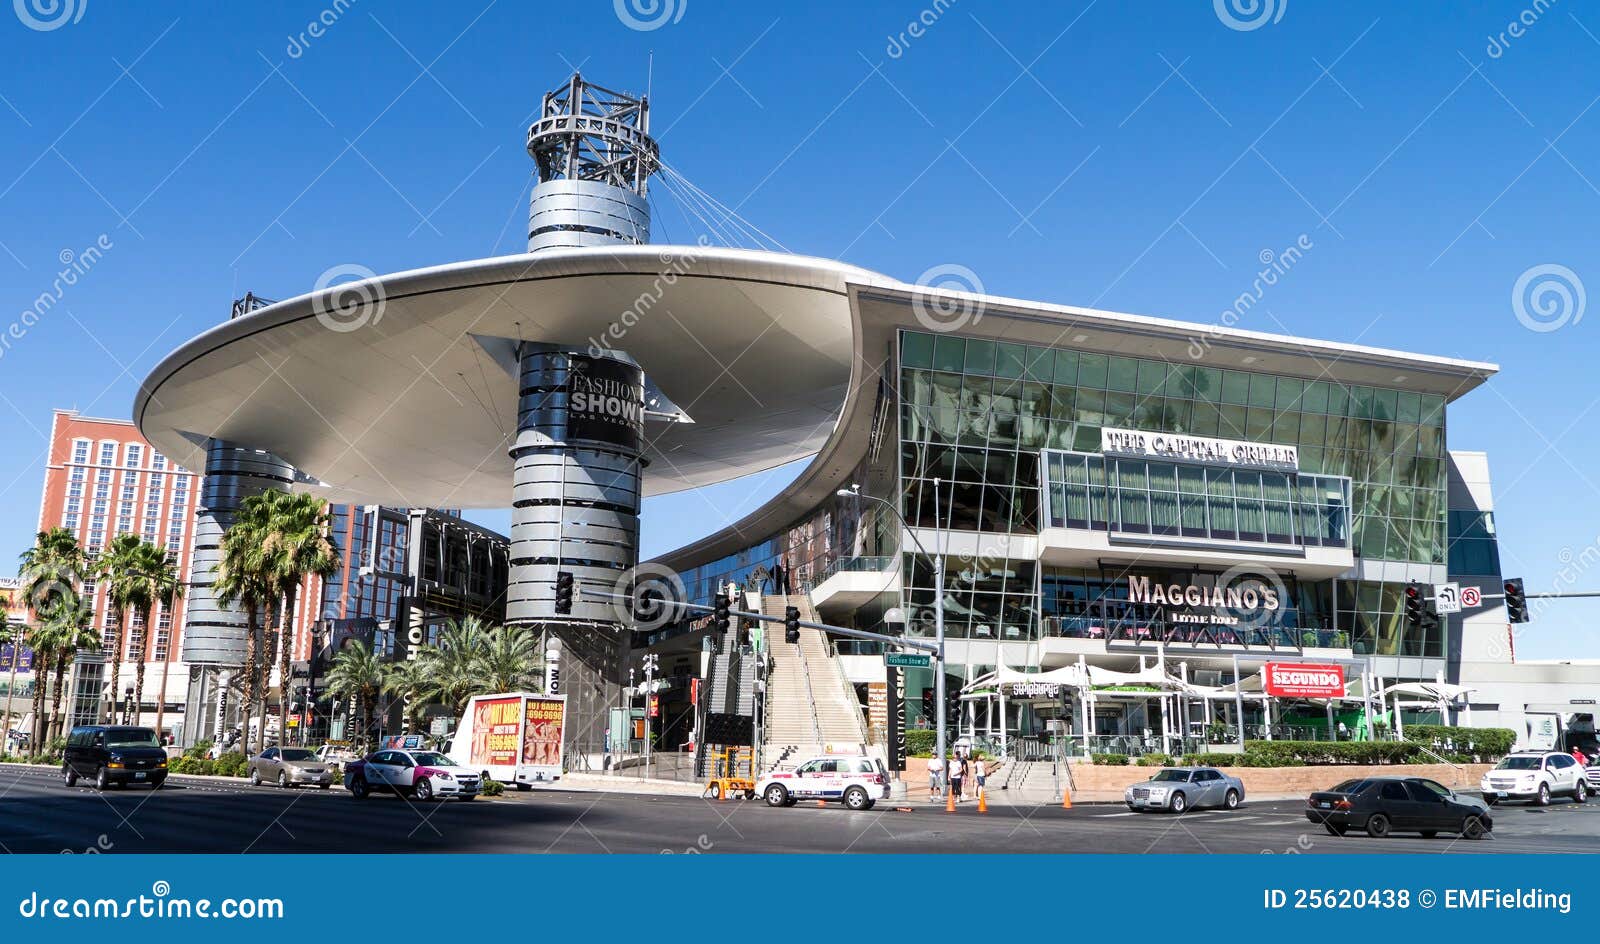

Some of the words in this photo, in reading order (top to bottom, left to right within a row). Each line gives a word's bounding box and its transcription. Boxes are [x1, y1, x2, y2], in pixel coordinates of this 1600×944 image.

[573, 376, 638, 401] FASHION
[571, 392, 639, 421] SHOW
[604, 416, 637, 429] VEGAS
[1107, 431, 1146, 448] THE
[1152, 436, 1226, 458] CAPITAL
[1231, 444, 1297, 464] GRILLE
[1128, 575, 1279, 610] MAGGIANO'S
[407, 605, 424, 660] HOW
[1272, 672, 1340, 687] SEGUNDO
[219, 692, 227, 718] SHOW
[897, 700, 906, 762] FASHION
